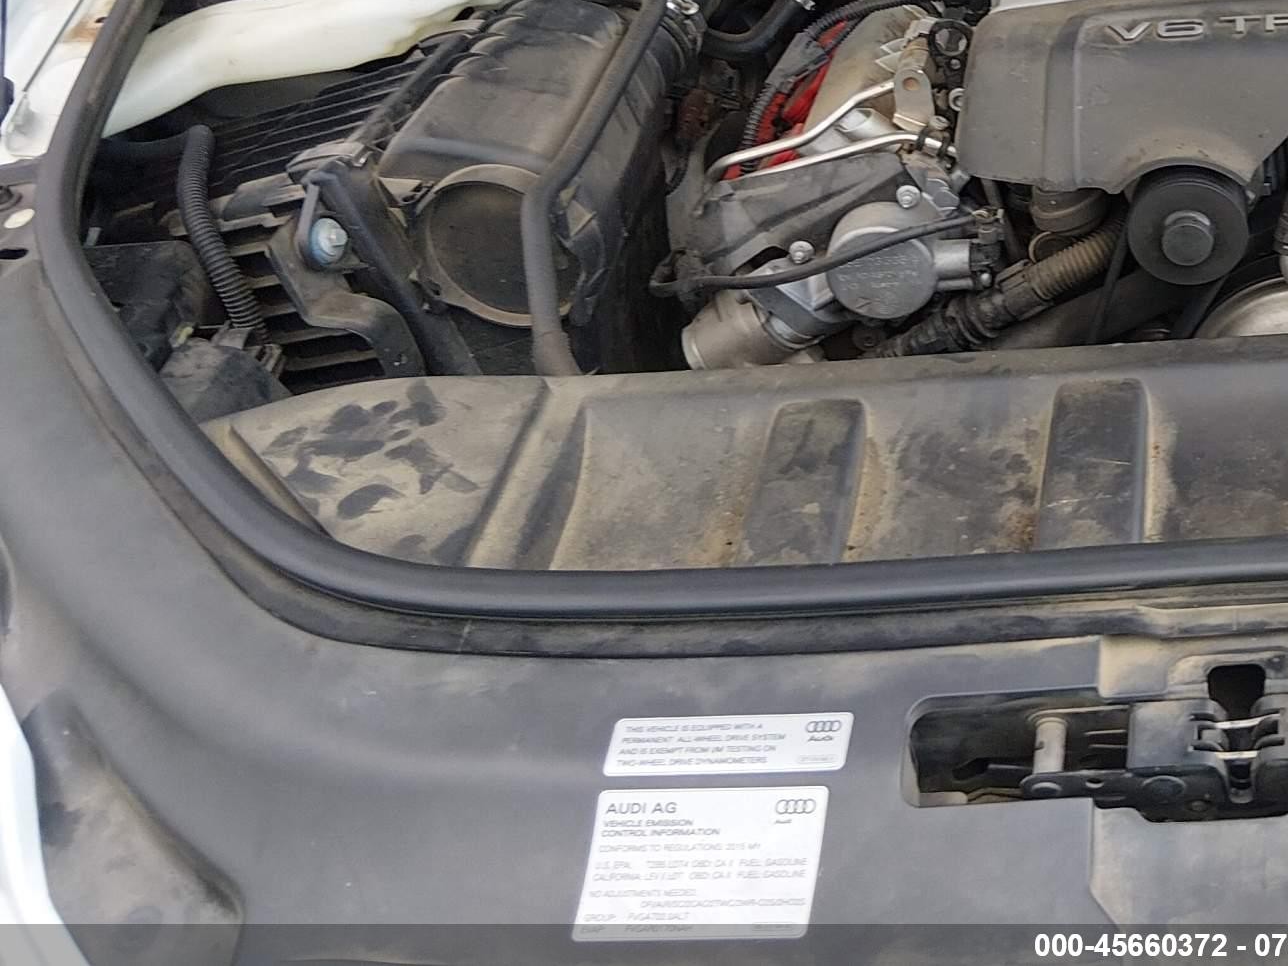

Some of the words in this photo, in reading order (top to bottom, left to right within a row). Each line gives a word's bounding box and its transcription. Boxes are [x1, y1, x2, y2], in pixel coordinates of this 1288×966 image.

[1107, 19, 1204, 44] V6
[806, 734, 834, 742] Audi
[605, 802, 647, 815] AUDI
[651, 801, 678, 814] AG
[603, 819, 643, 828] VEHICLE
[645, 818, 694, 827] EMISSION
[601, 829, 648, 838] CONTROL
[649, 827, 721, 837] INFORMATION
